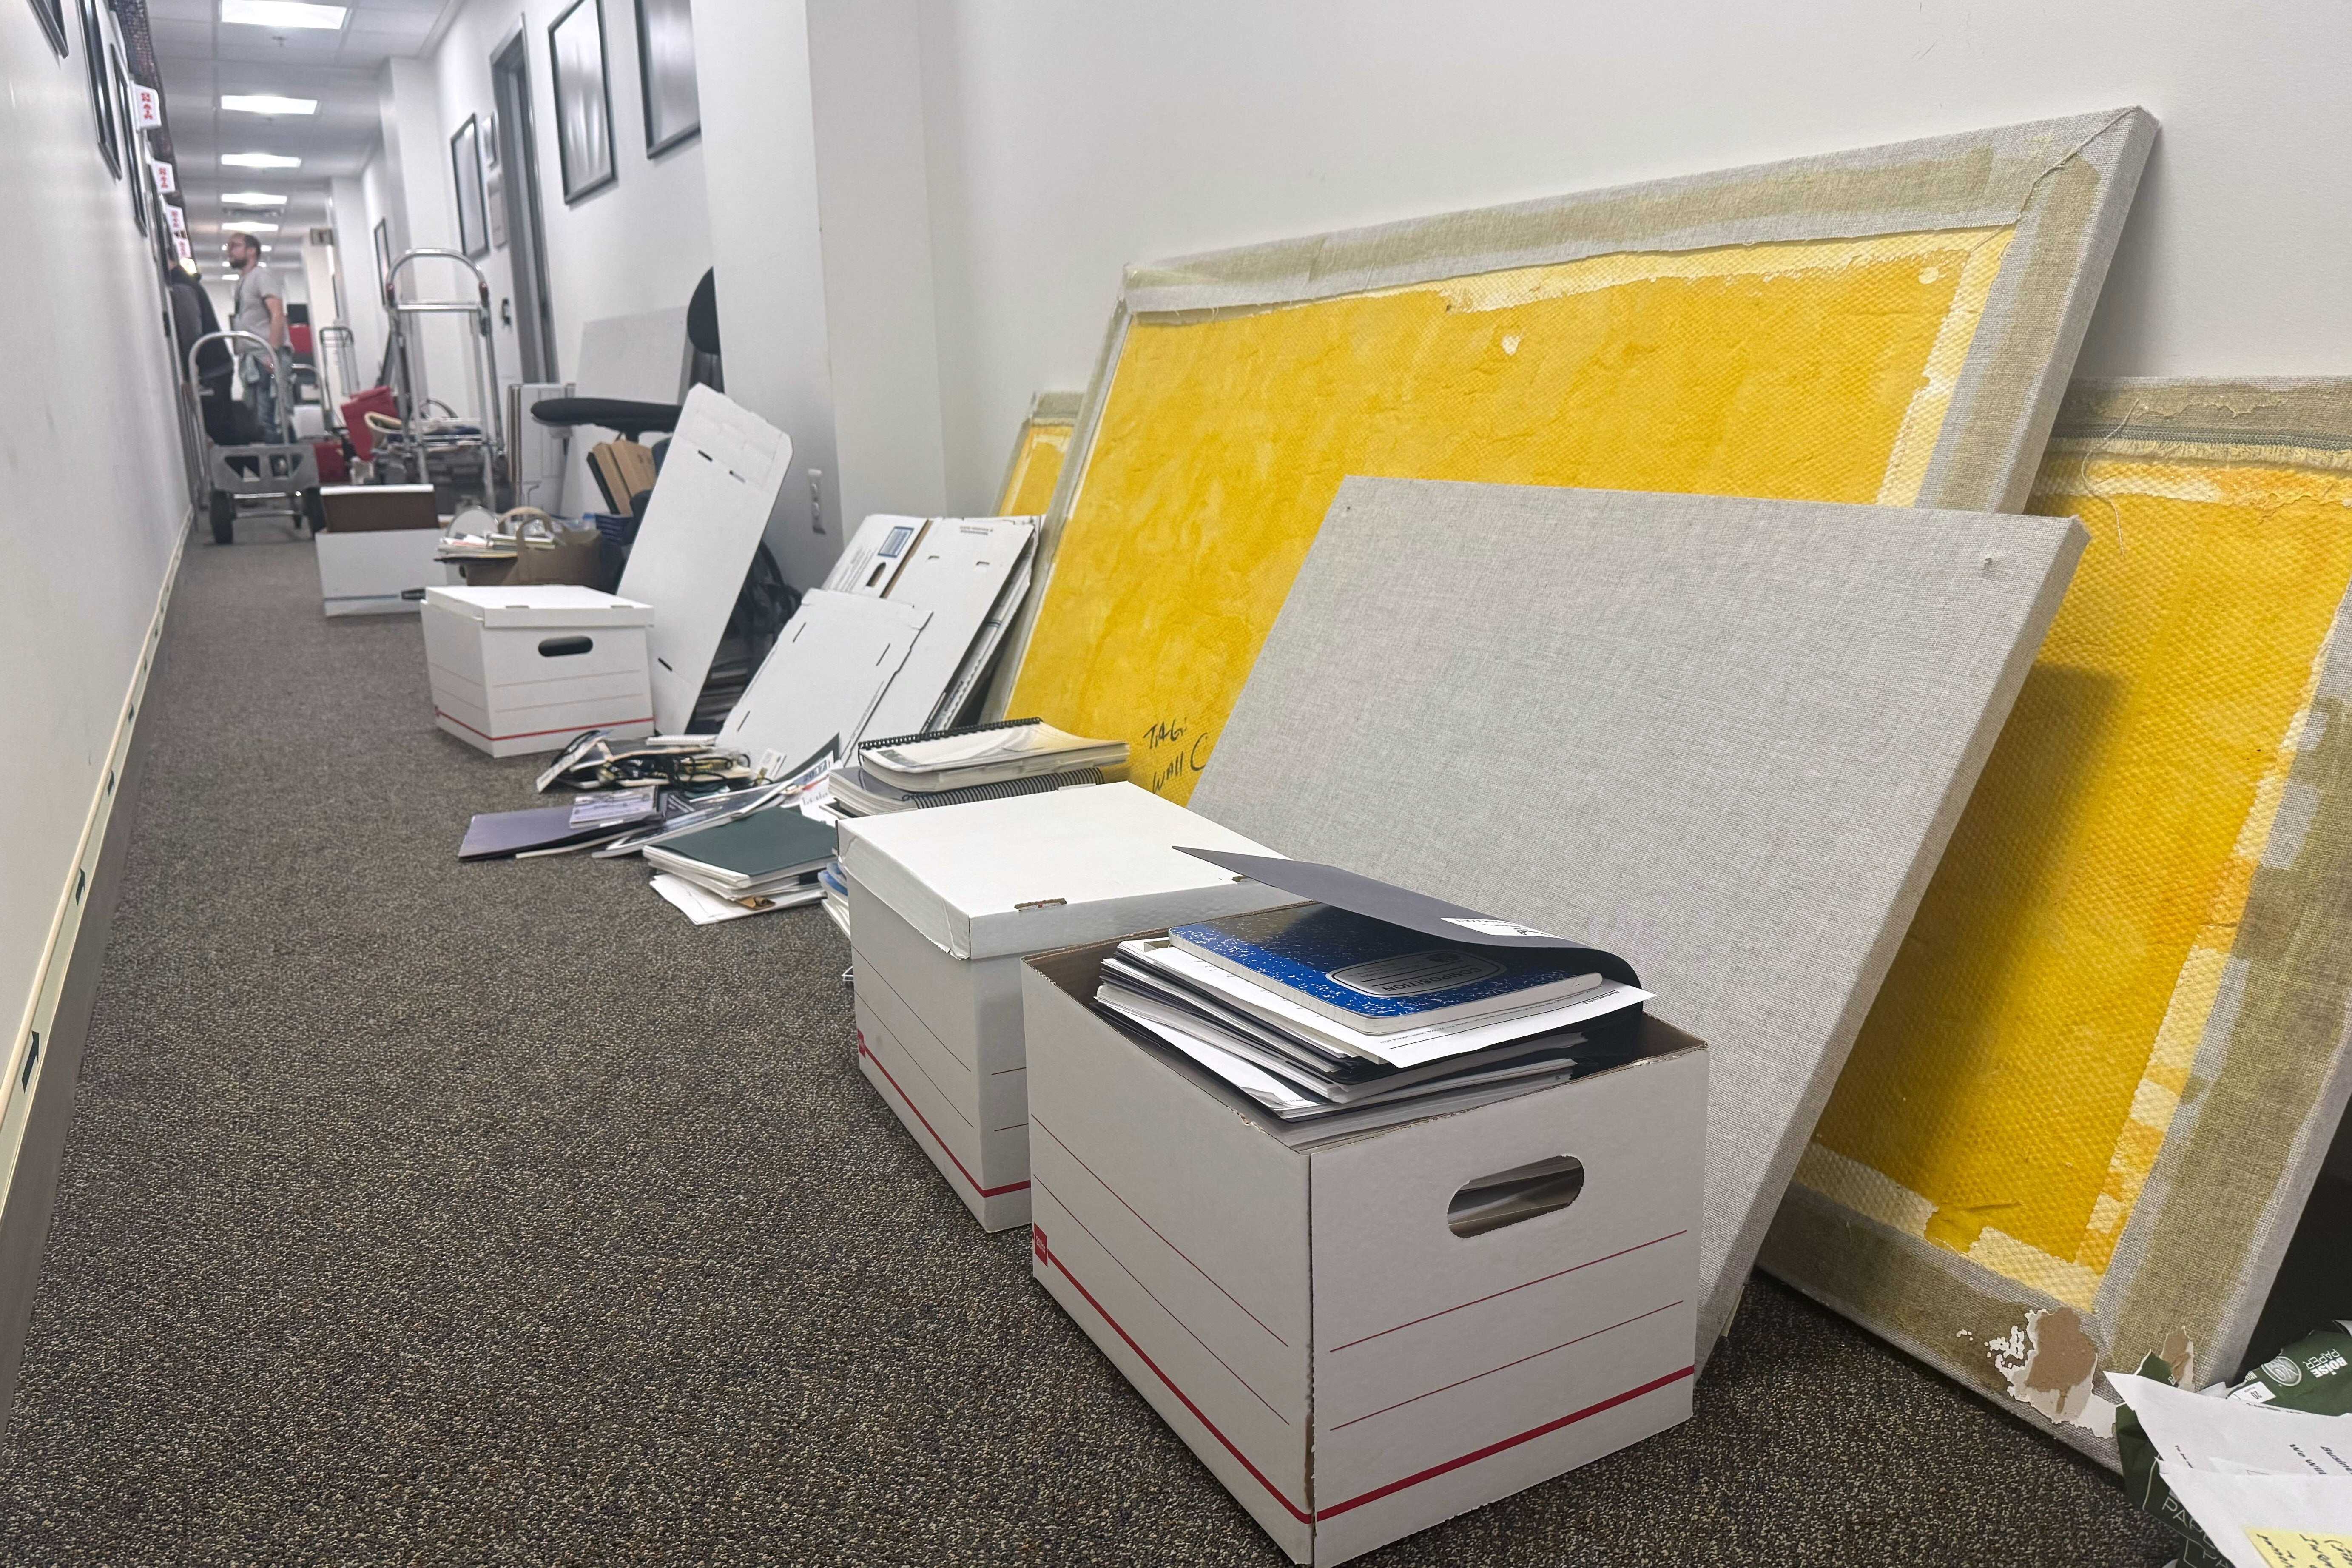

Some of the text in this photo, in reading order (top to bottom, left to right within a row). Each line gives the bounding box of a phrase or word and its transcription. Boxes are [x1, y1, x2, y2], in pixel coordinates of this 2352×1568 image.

[1382, 967, 1482, 992] COMPOSITION
[2302, 1348, 2341, 1369] PAPER
[2250, 1391, 2262, 1400] 20
